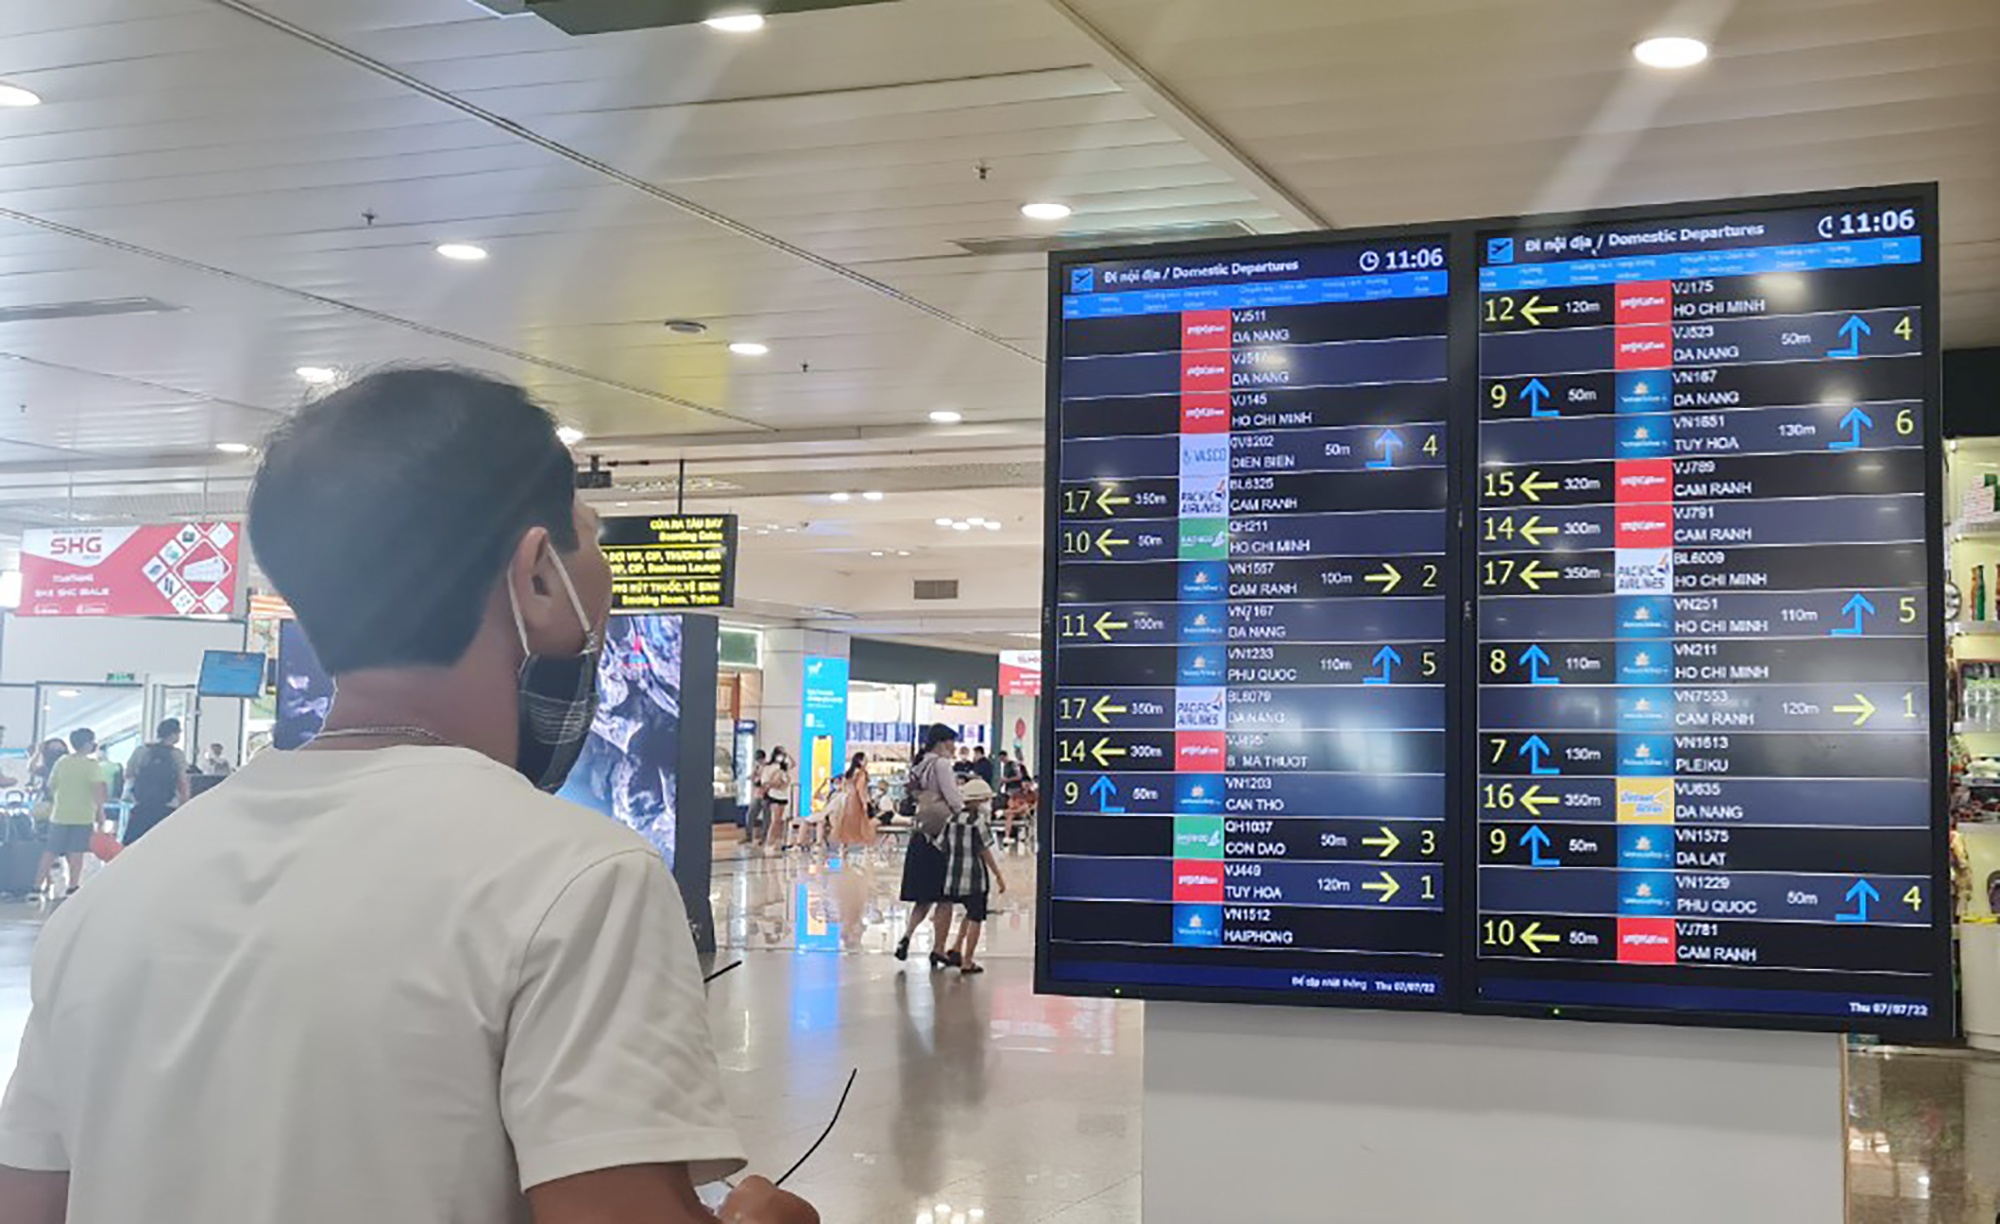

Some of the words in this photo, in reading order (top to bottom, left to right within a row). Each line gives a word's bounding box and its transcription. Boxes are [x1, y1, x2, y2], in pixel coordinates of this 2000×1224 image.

[1841, 211, 1915, 235] 11:06
[1609, 230, 1676, 247] Domestic
[1681, 224, 1764, 244] Departures
[1386, 248, 1443, 270] 11:06
[1173, 262, 1228, 279] Domestic
[1232, 260, 1299, 277] Departures
[1672, 281, 1714, 295] VJ175
[1484, 297, 1514, 322] 12
[1566, 301, 1600, 313] 120m
[1674, 305, 1695, 317] HO
[1700, 304, 1724, 316] CHI
[1727, 300, 1765, 314] MINH
[1232, 329, 1253, 343] DA
[1255, 328, 1290, 342] NANG
[1782, 334, 1811, 346] 50m
[1894, 316, 1912, 341] 4
[1674, 349, 1695, 362] DA
[1700, 346, 1740, 360] NANG
[1232, 372, 1252, 385] DA
[1255, 370, 1290, 384] NANG
[1232, 393, 1267, 406] VJ145
[1490, 384, 1507, 409] 9
[1568, 388, 1597, 402] 50m
[1674, 394, 1696, 407] DA
[1700, 391, 1740, 405] NANG
[1232, 414, 1250, 427] HO
[1254, 413, 1275, 426] CHI
[1279, 412, 1312, 425] MINH
[1778, 424, 1816, 436] 130m
[1895, 410, 1913, 434] 6
[1325, 444, 1350, 455] 50m
[1422, 434, 1438, 456] 4
[1675, 438, 1702, 452] TUY
[1706, 437, 1739, 450] HOA
[1264, 456, 1294, 467] BIEN
[1484, 472, 1514, 496] 15
[1564, 478, 1600, 490] 320m
[1674, 484, 1707, 497] CAM
[1710, 482, 1752, 495] RANH
[1064, 490, 1091, 513] 17
[1135, 493, 1167, 505] 350m
[1230, 500, 1258, 511] CAM
[1262, 498, 1297, 510] RANH
[1674, 507, 1714, 520] VJ791
[1484, 516, 1514, 540] 14
[1564, 522, 1600, 535] 300m
[1674, 529, 1707, 542] CAM
[1710, 527, 1752, 541] RANH
[50, 536, 102, 555] SHG
[1064, 530, 1090, 554] 10
[1138, 535, 1163, 546] 50m
[1230, 542, 1248, 553] HO
[1252, 542, 1273, 552] CHI
[1277, 540, 1310, 552] MINH
[1321, 573, 1352, 584] 100m
[1422, 565, 1437, 588] 2
[1484, 561, 1514, 585] 17
[1564, 567, 1600, 580] 350m
[1675, 575, 1696, 588] HO
[1702, 574, 1726, 587] CHI
[1729, 573, 1767, 586] MINH
[1229, 585, 1258, 596] CAM
[1260, 584, 1297, 594] RANH
[1781, 608, 1818, 622] 110m
[1898, 598, 1916, 622] 5
[1062, 614, 1088, 636] 11
[1228, 627, 1246, 638] DA
[1249, 626, 1286, 637] NANG
[1676, 620, 1696, 634] HO
[1702, 620, 1726, 633] CHI
[1730, 618, 1768, 632] MINH
[1674, 644, 1717, 656] VN211
[1321, 659, 1352, 670] 110m
[1422, 652, 1436, 676] 5
[1490, 649, 1507, 674] 8
[1566, 658, 1600, 670] 110m
[1228, 670, 1254, 682] PHU
[1258, 668, 1297, 680] QUOC
[1676, 666, 1696, 679] HO
[1702, 666, 1726, 679] CHI
[1730, 666, 1768, 679] MINH
[1060, 698, 1086, 720] 17
[1782, 702, 1819, 716] 120m
[1902, 692, 1917, 718] 1
[1676, 712, 1708, 726] CAM
[1712, 713, 1754, 726] RANH
[1059, 740, 1086, 762] 14
[1490, 738, 1507, 764] 7
[1565, 748, 1600, 761] 130m
[1264, 756, 1308, 767] THUOT
[1676, 758, 1728, 772] PLEIKU
[1064, 782, 1079, 804] 9
[1484, 783, 1514, 809] 16
[1226, 799, 1252, 811] CAN
[1255, 799, 1285, 811] THO
[1676, 806, 1697, 819] DA
[1700, 806, 1743, 819] NANG
[1225, 842, 1254, 854] CON
[1257, 842, 1286, 855] DAO
[1321, 834, 1348, 846] 50m
[1420, 830, 1435, 854] 3
[1490, 828, 1507, 854] 9
[1569, 838, 1598, 852] 50m
[1676, 852, 1698, 866] DA
[1701, 852, 1726, 866] LAT
[1318, 878, 1350, 891] 120m
[1420, 876, 1435, 900] 1
[1676, 876, 1730, 890] VN1229
[1225, 886, 1250, 898] TUY
[1254, 886, 1282, 898] HOA
[1787, 891, 1818, 906] 50m
[1902, 884, 1922, 912] 4
[1678, 900, 1708, 913] PHU
[1712, 900, 1757, 914] QUOC
[1224, 930, 1293, 944] HAIPHONG
[1484, 919, 1514, 946] 10
[1569, 931, 1598, 944] 50m
[1676, 946, 1711, 960] CAM
[1714, 947, 1756, 962] RANH
[1850, 1002, 1870, 1013] Thu
